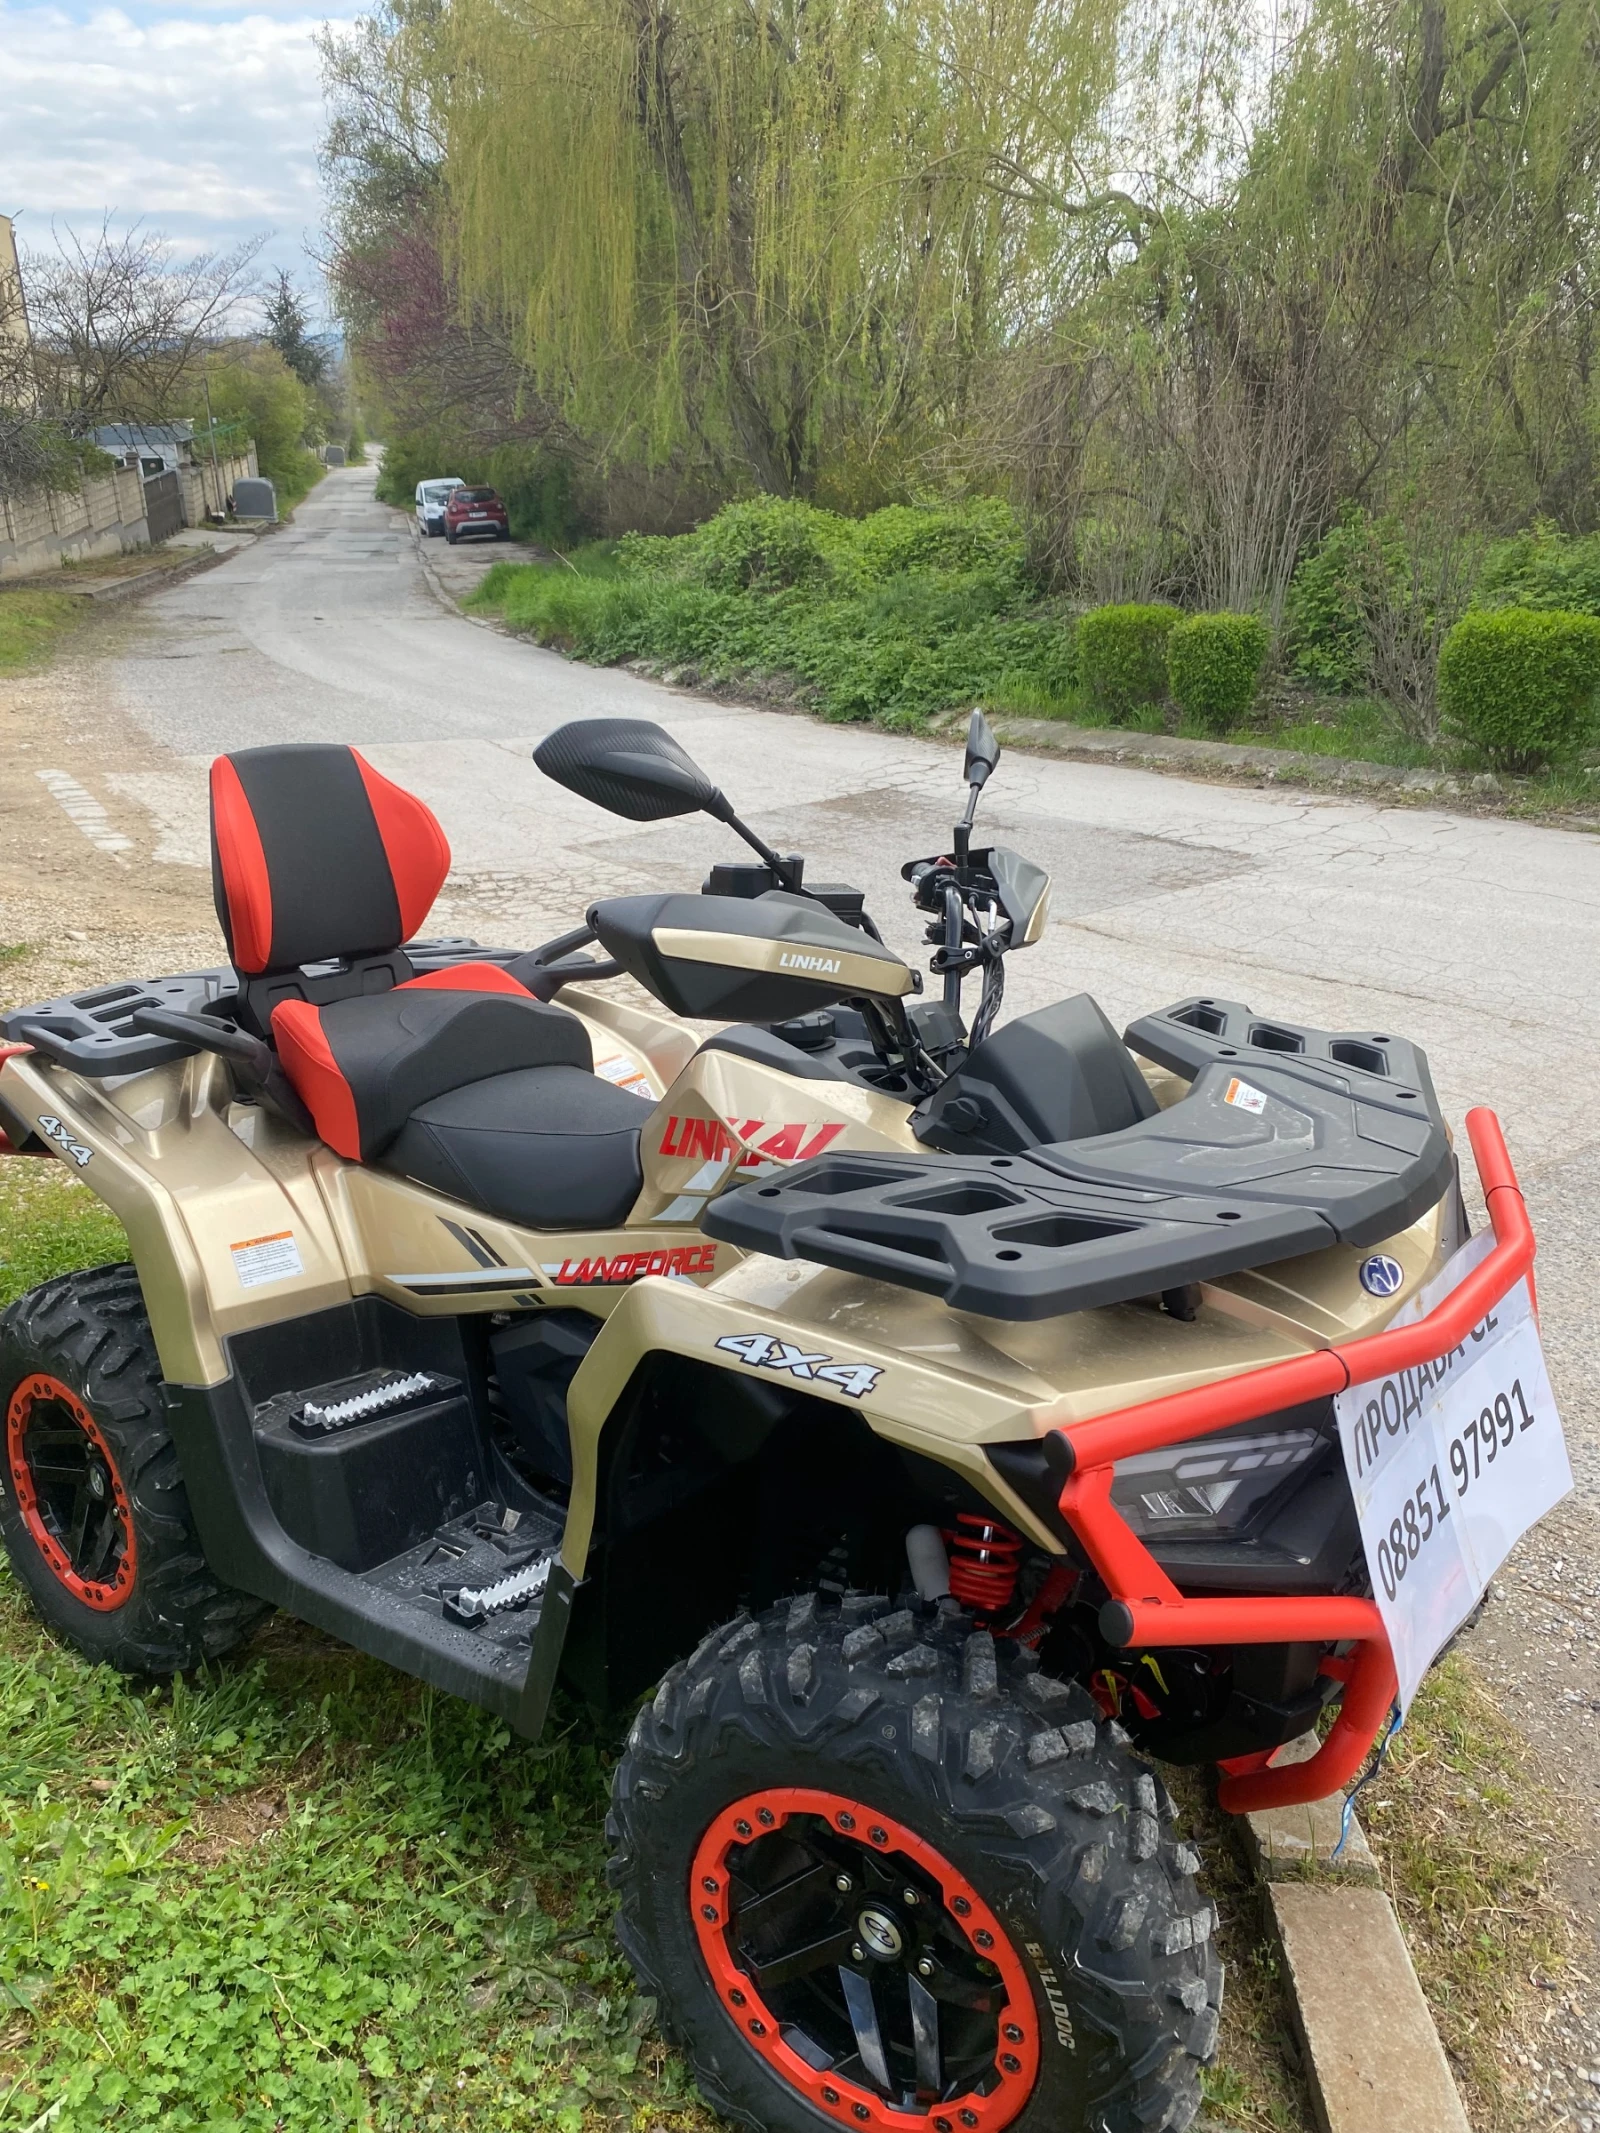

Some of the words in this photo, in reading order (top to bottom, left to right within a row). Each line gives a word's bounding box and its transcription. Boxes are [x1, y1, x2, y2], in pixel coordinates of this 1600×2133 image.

[779, 953, 841, 973] LINHAI
[659, 1116, 847, 1167] LINHAI
[555, 1244, 717, 1284] LANDFORCE
[1025, 1942, 1076, 2050] BULLDOG
